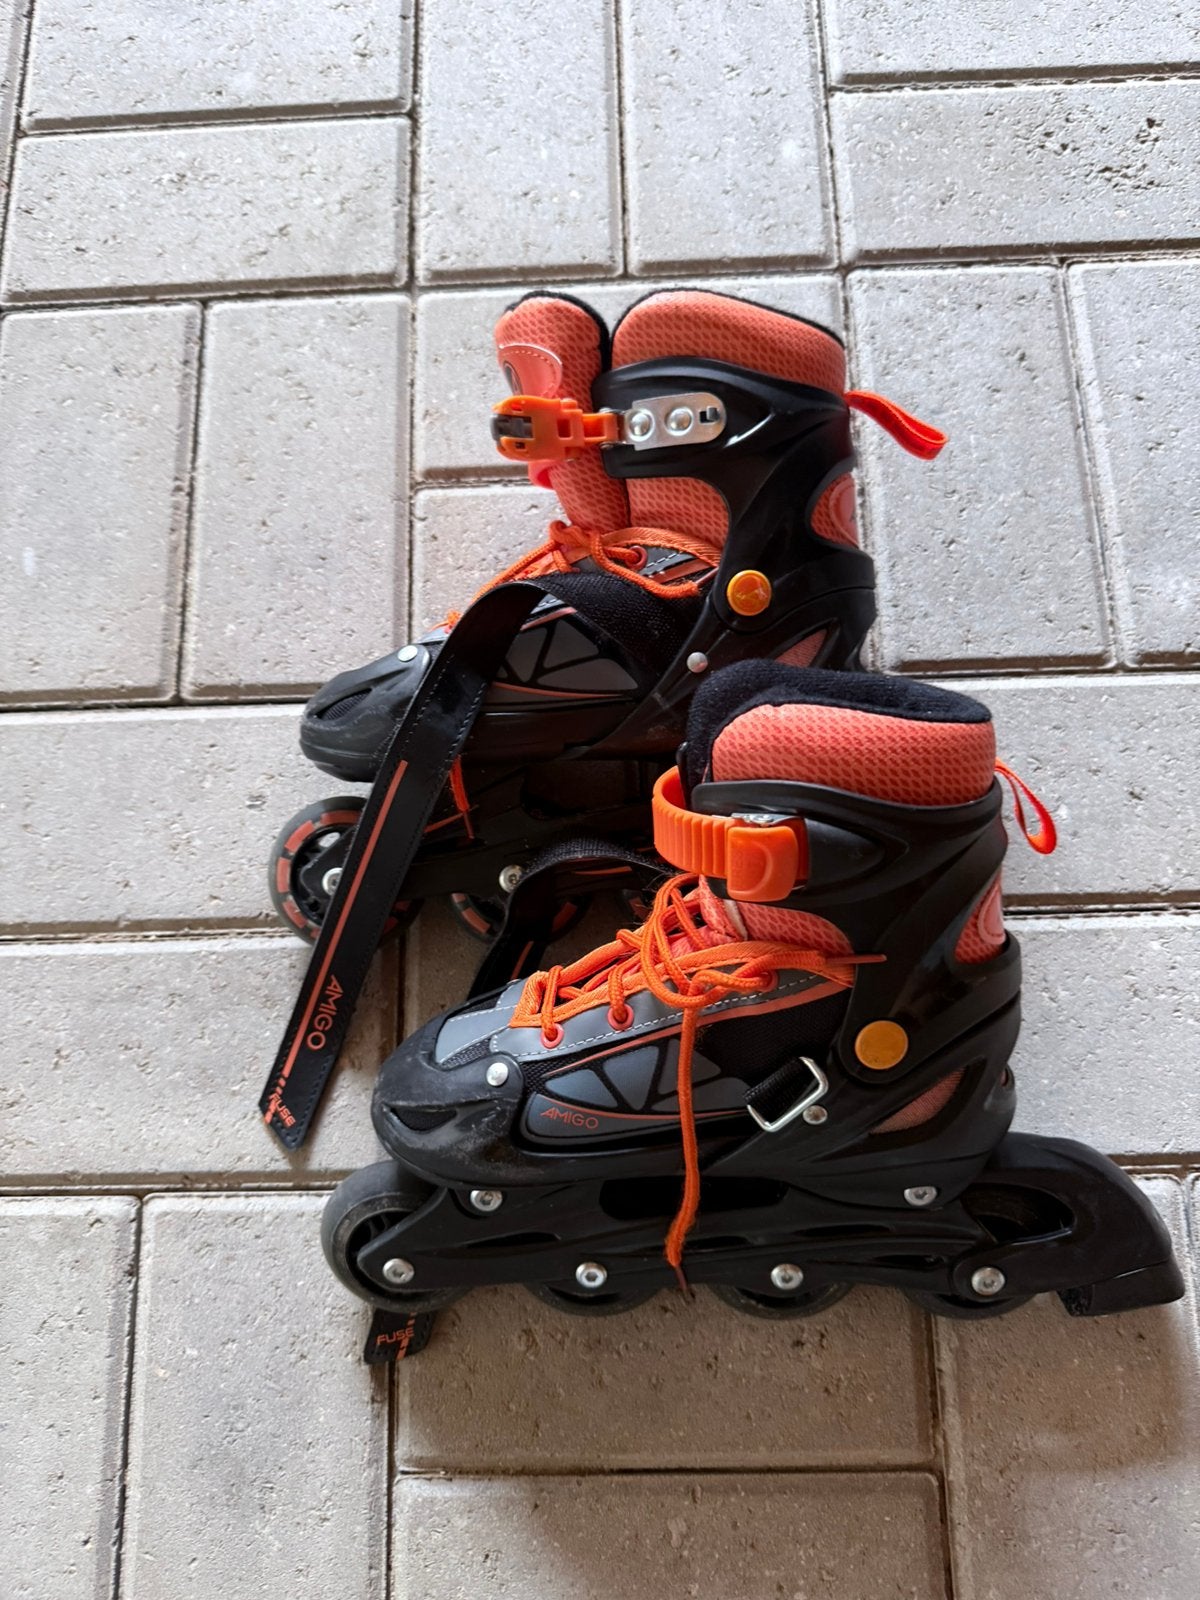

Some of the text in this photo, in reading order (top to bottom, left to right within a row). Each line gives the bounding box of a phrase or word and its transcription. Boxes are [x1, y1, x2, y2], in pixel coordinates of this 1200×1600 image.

[306, 974, 344, 1050] AMIGO
[268, 1092, 297, 1128] FUSE
[540, 1106, 600, 1130] AMIGO
[376, 1327, 415, 1346] FUSE
